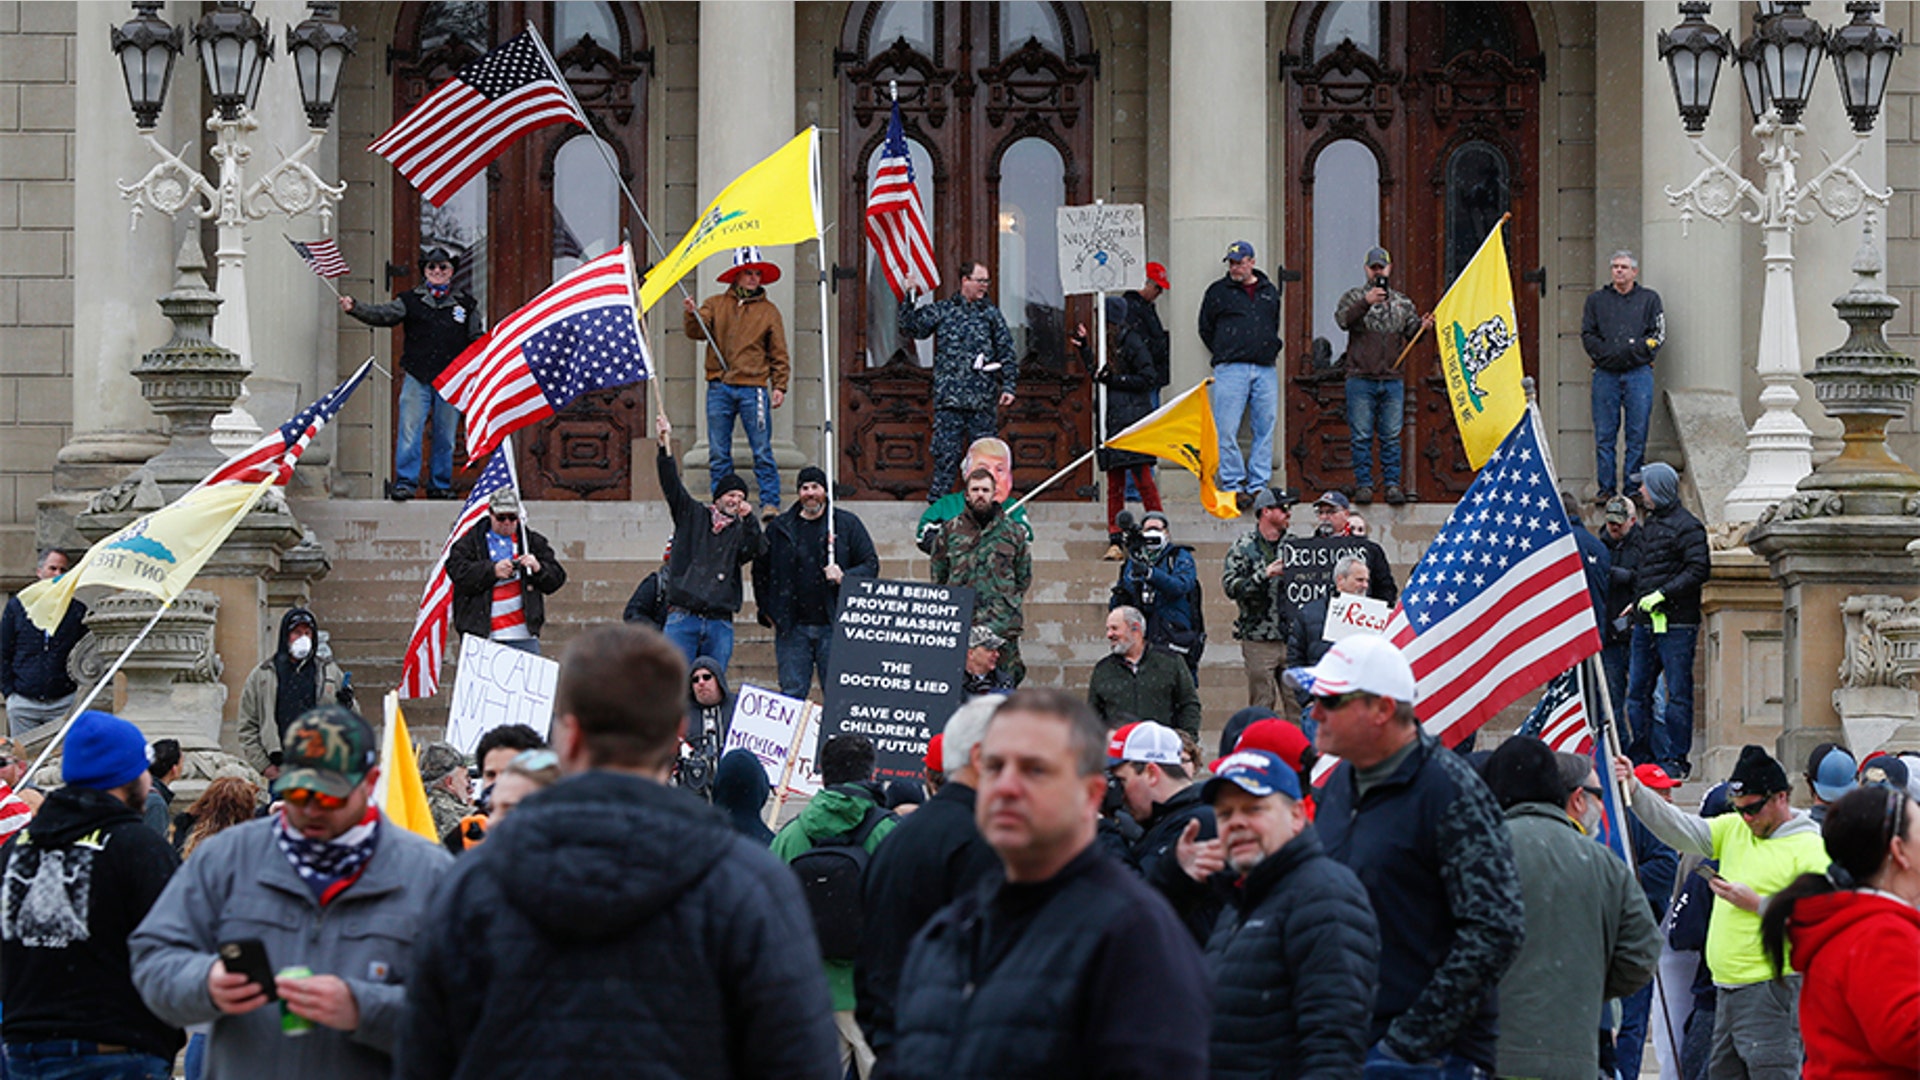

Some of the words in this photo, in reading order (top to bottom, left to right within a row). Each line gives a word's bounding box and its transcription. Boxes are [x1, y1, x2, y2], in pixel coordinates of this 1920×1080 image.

[1283, 543, 1367, 568] DECISIONS
[876, 583, 898, 596] AM
[903, 586, 950, 601] BEING
[1287, 582, 1328, 603] COM
[847, 596, 909, 613] PROVEN
[911, 603, 960, 617] RIGHT
[1332, 602, 1386, 630] #Reca
[839, 611, 893, 627] ABOUT
[895, 617, 962, 633] MASSIVE
[844, 627, 957, 648] VACCINATIONS
[463, 636, 549, 700] RECALL
[881, 661, 912, 675] THE
[840, 673, 911, 691] DOCTORS
[915, 680, 949, 694] LIED
[741, 692, 795, 725] OPEN
[850, 705, 889, 720] SAVE
[893, 709, 926, 723] OUR
[840, 720, 916, 738] CHILDREN
[919, 728, 931, 739] &
[877, 739, 929, 755] FUTUR
